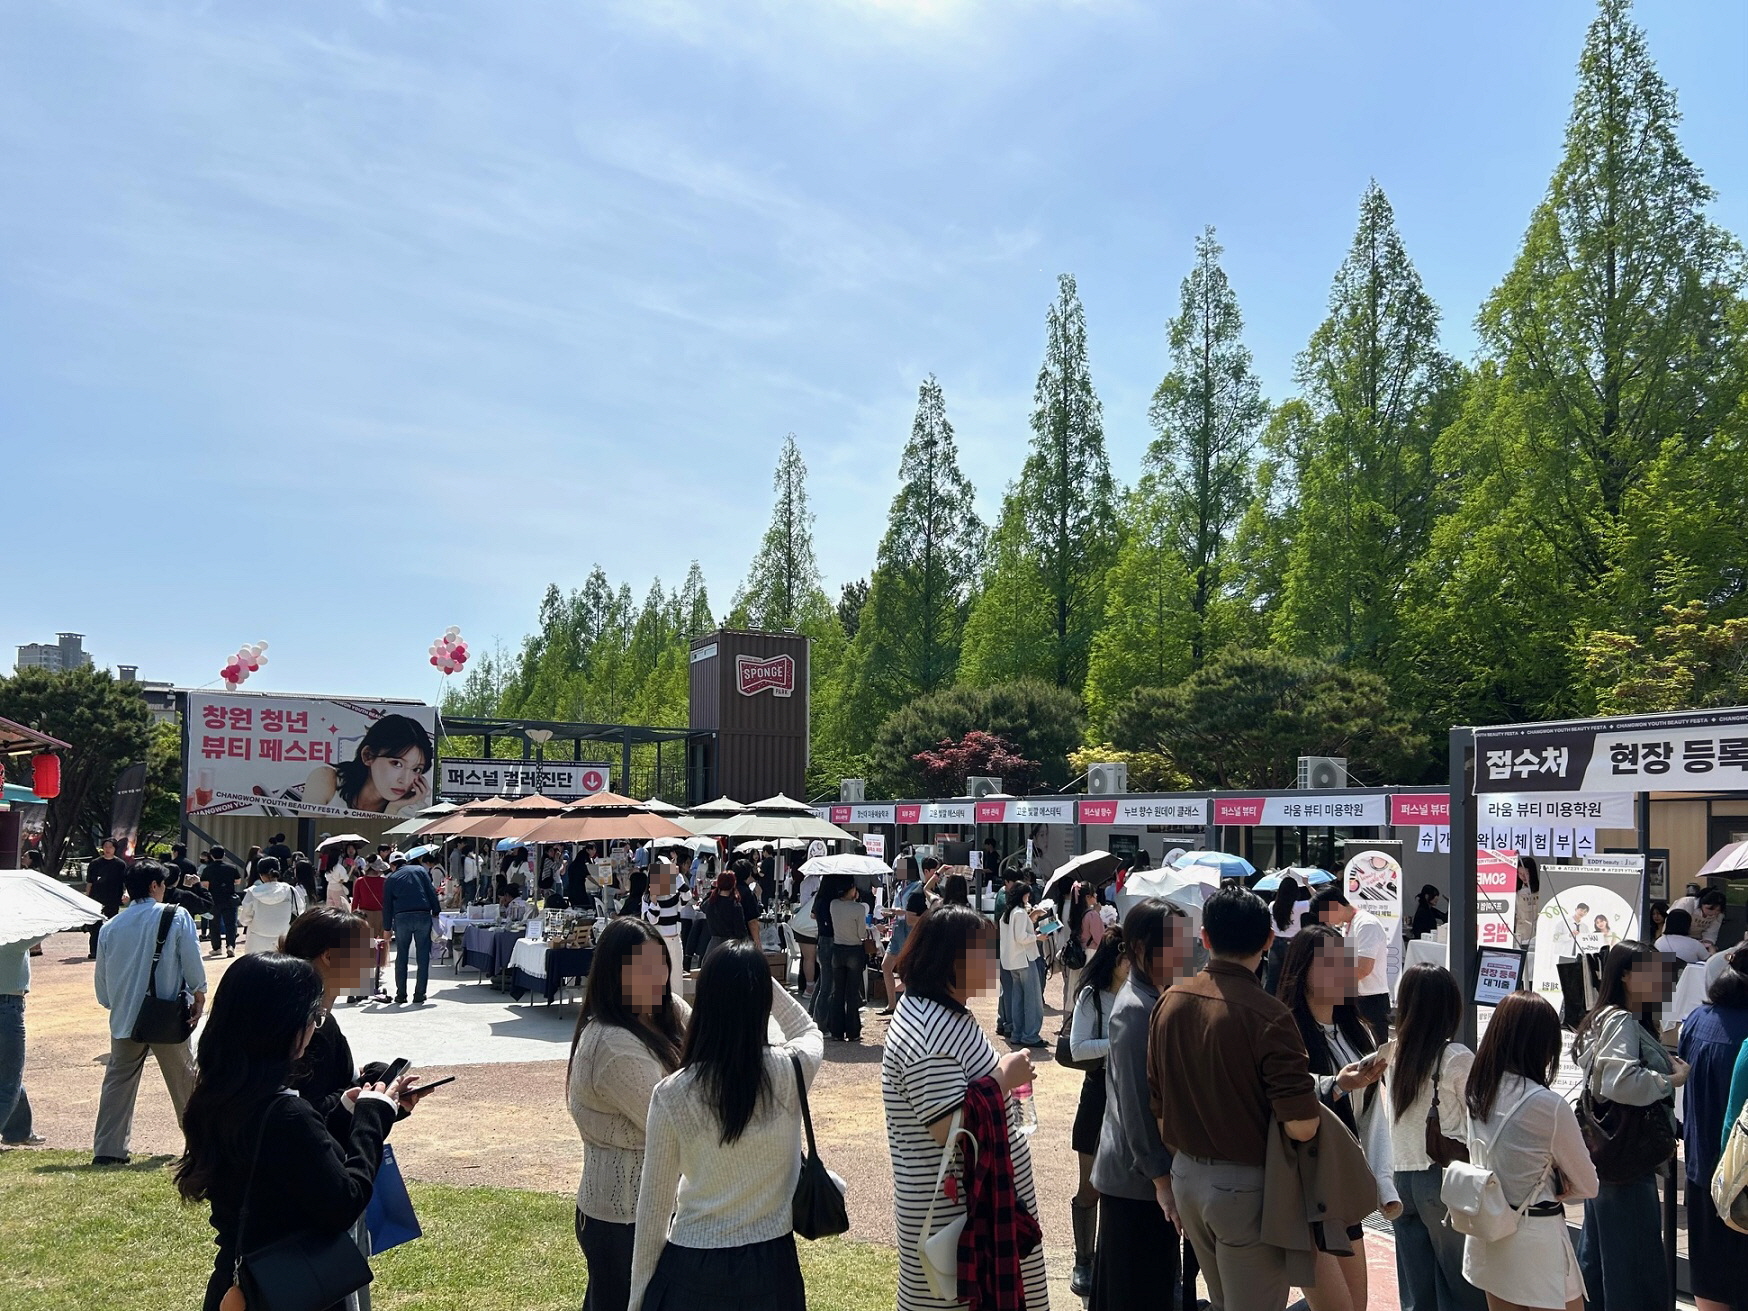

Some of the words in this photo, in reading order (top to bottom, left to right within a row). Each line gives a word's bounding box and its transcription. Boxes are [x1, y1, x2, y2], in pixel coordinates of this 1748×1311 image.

[744, 666, 783, 680] SPONGE
[203, 705, 252, 731] 창원
[261, 709, 308, 733] 청년
[202, 735, 252, 761] 뷰티
[259, 738, 332, 764] 페스타
[1486, 746, 1568, 780] 접수처
[1609, 742, 1674, 775] 현장
[1683, 738, 1748, 773] 등록
[447, 769, 498, 786] 퍼스널
[504, 770, 538, 788] 컬러
[541, 771, 572, 788] 진단
[216, 791, 260, 803] CHANGWON
[262, 798, 287, 807] YOUTH
[288, 802, 317, 812] BEAUTY
[317, 806, 341, 814] FESTA
[1139, 806, 1152, 817] 향수
[1154, 806, 1175, 817] 원데이
[1177, 806, 1200, 817] 클래스
[1221, 806, 1241, 817] 퍼스널
[1242, 806, 1257, 816] 뷰티
[1283, 804, 1301, 817] 라움
[1304, 804, 1322, 817] 뷰티
[1325, 804, 1364, 817] 미용학원
[1400, 804, 1428, 816] 퍼스널
[1430, 804, 1450, 816] 뷰티
[1488, 802, 1513, 818] 라움
[1516, 802, 1542, 817] 뷰티
[1546, 802, 1602, 818] 미용학원
[1481, 968, 1498, 977] 현장
[1499, 970, 1516, 980] 등록
[1484, 978, 1510, 989] 대기줄
